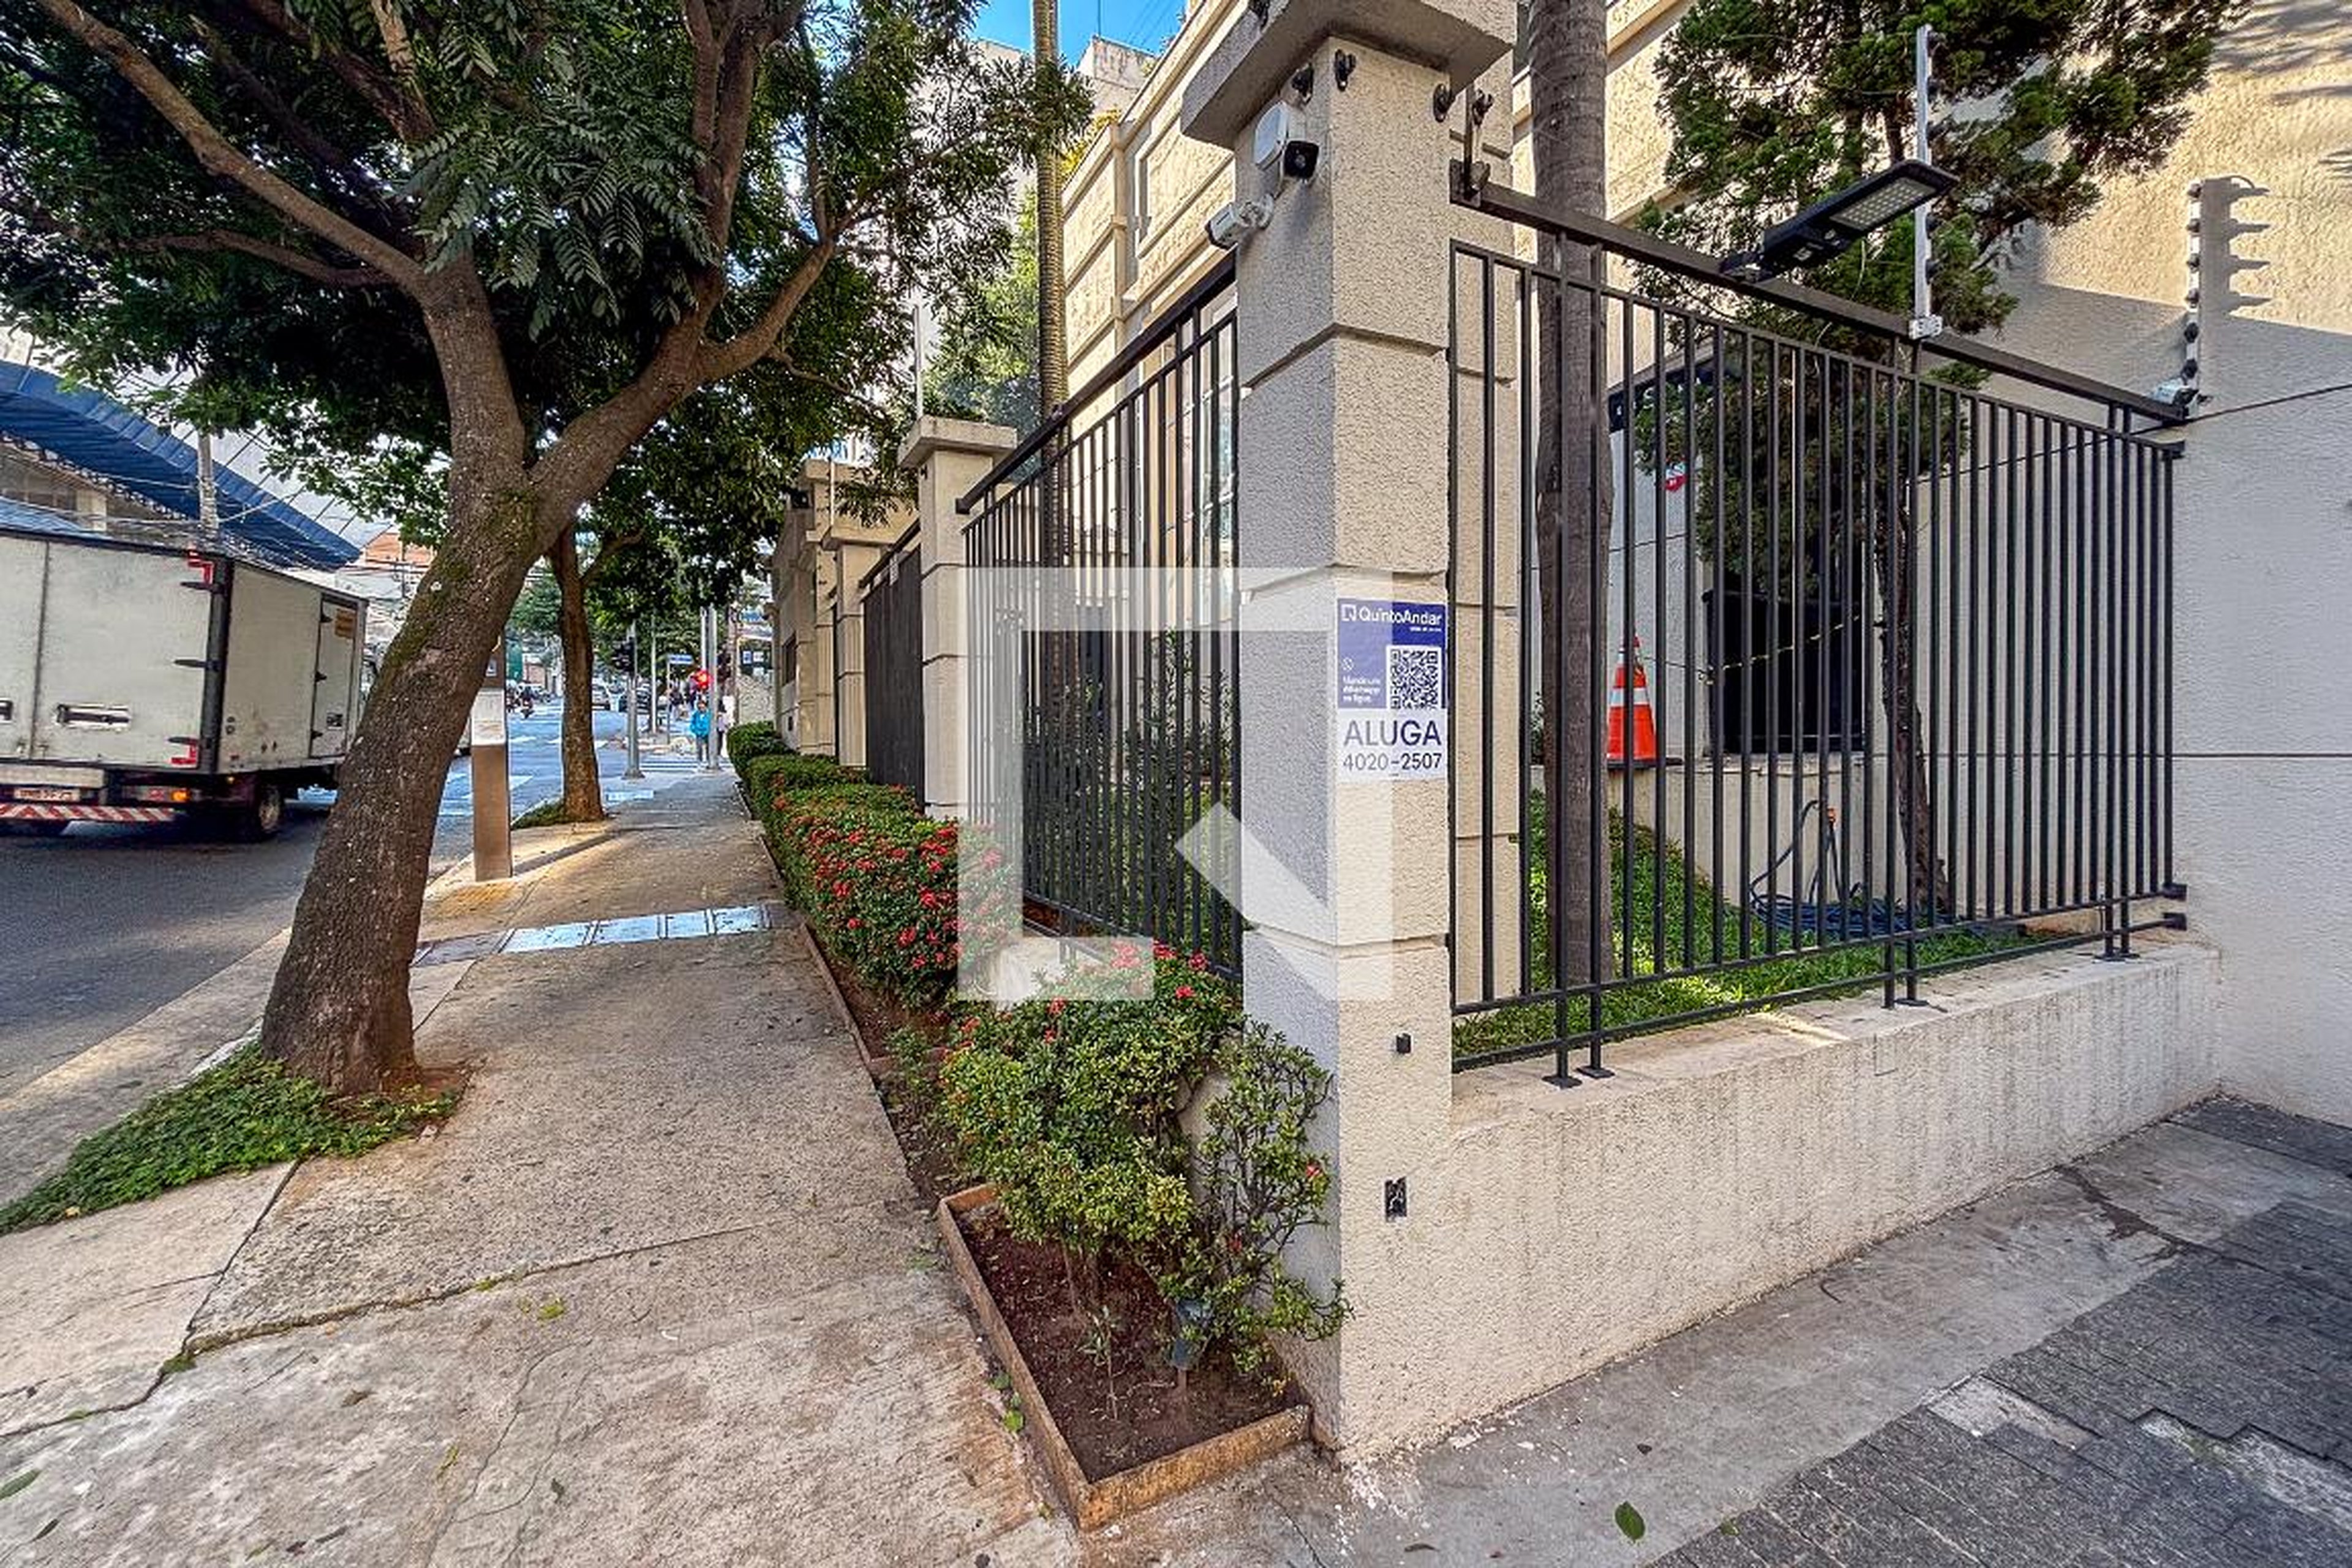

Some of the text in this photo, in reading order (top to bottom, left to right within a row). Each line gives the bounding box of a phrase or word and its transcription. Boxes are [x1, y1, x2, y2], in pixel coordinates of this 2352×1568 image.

[1359, 606, 1442, 625] QuintoAndar
[1343, 720, 1442, 745] ALUGA
[1343, 753, 1442, 771] 4020-2507
